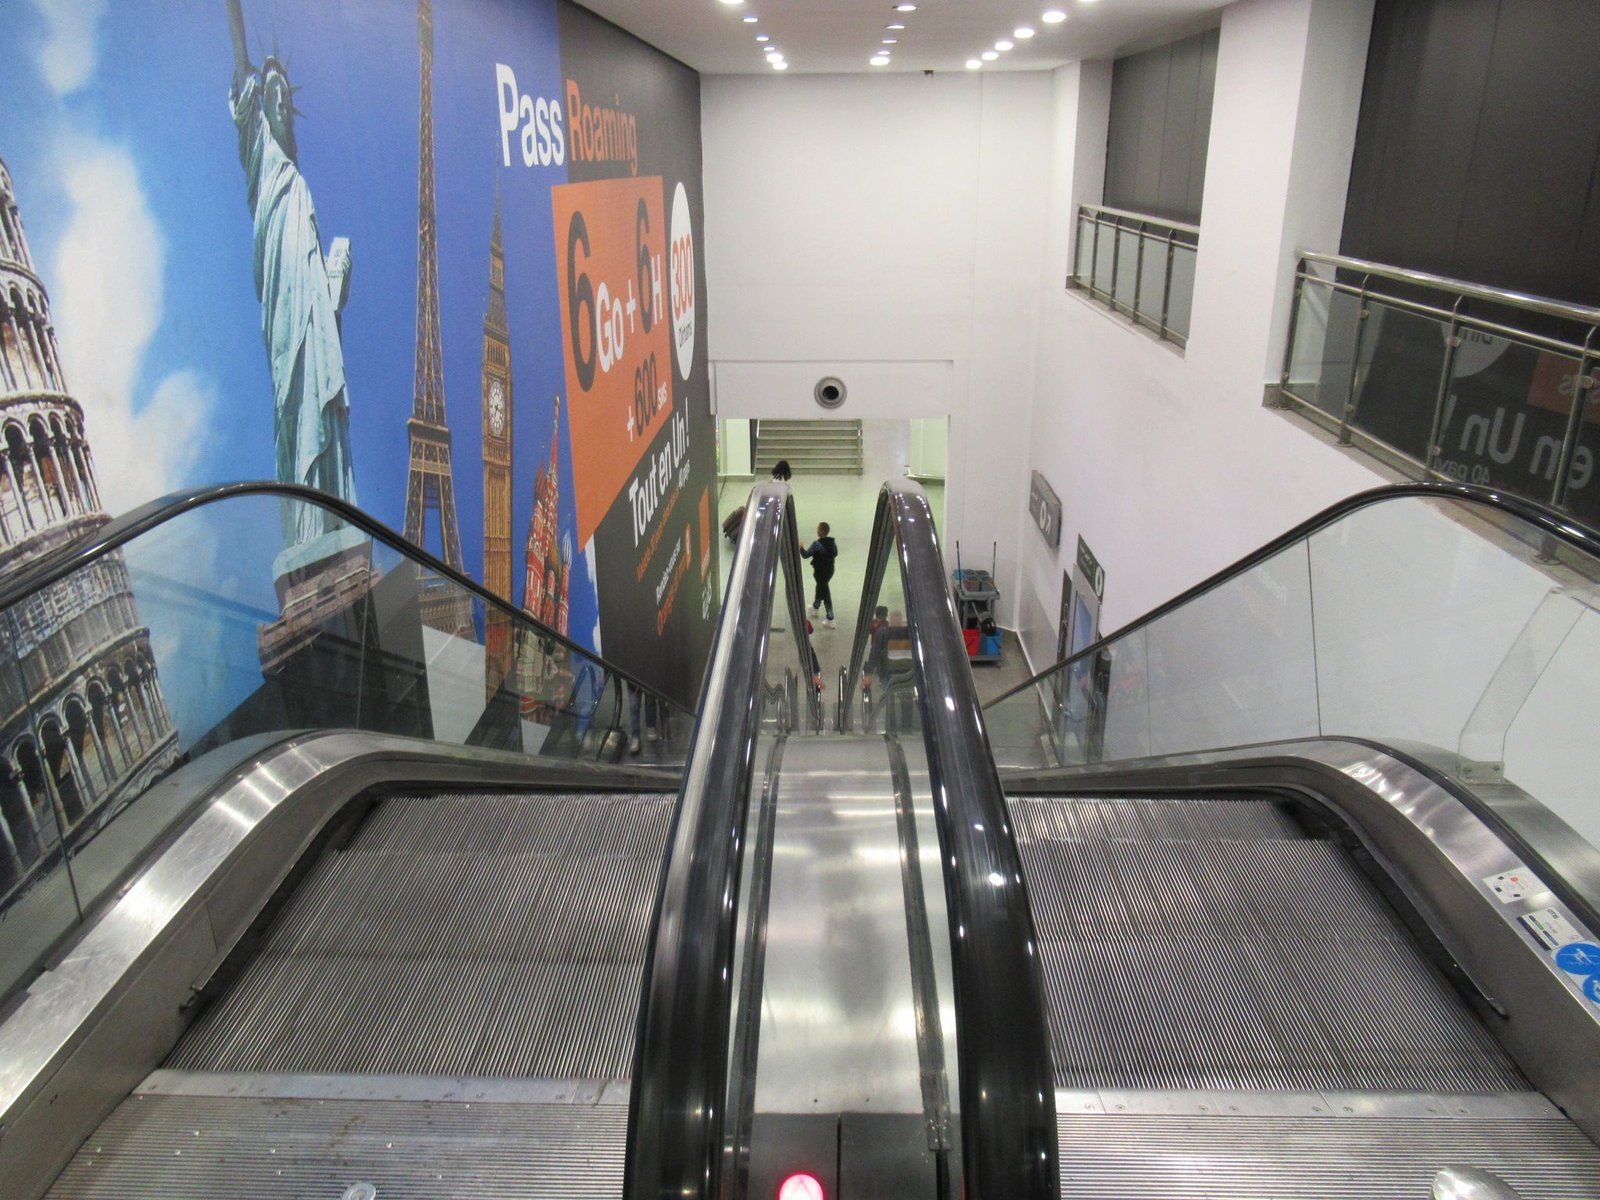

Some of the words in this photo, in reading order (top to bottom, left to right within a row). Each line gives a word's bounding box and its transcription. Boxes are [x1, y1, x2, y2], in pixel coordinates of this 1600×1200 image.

[496, 63, 565, 167] Pass
[566, 79, 638, 176] Roaming
[626, 279, 636, 333] +
[671, 232, 694, 321] 300
[634, 351, 658, 437] 600
[629, 455, 659, 547] Tout
[659, 441, 672, 496] en
